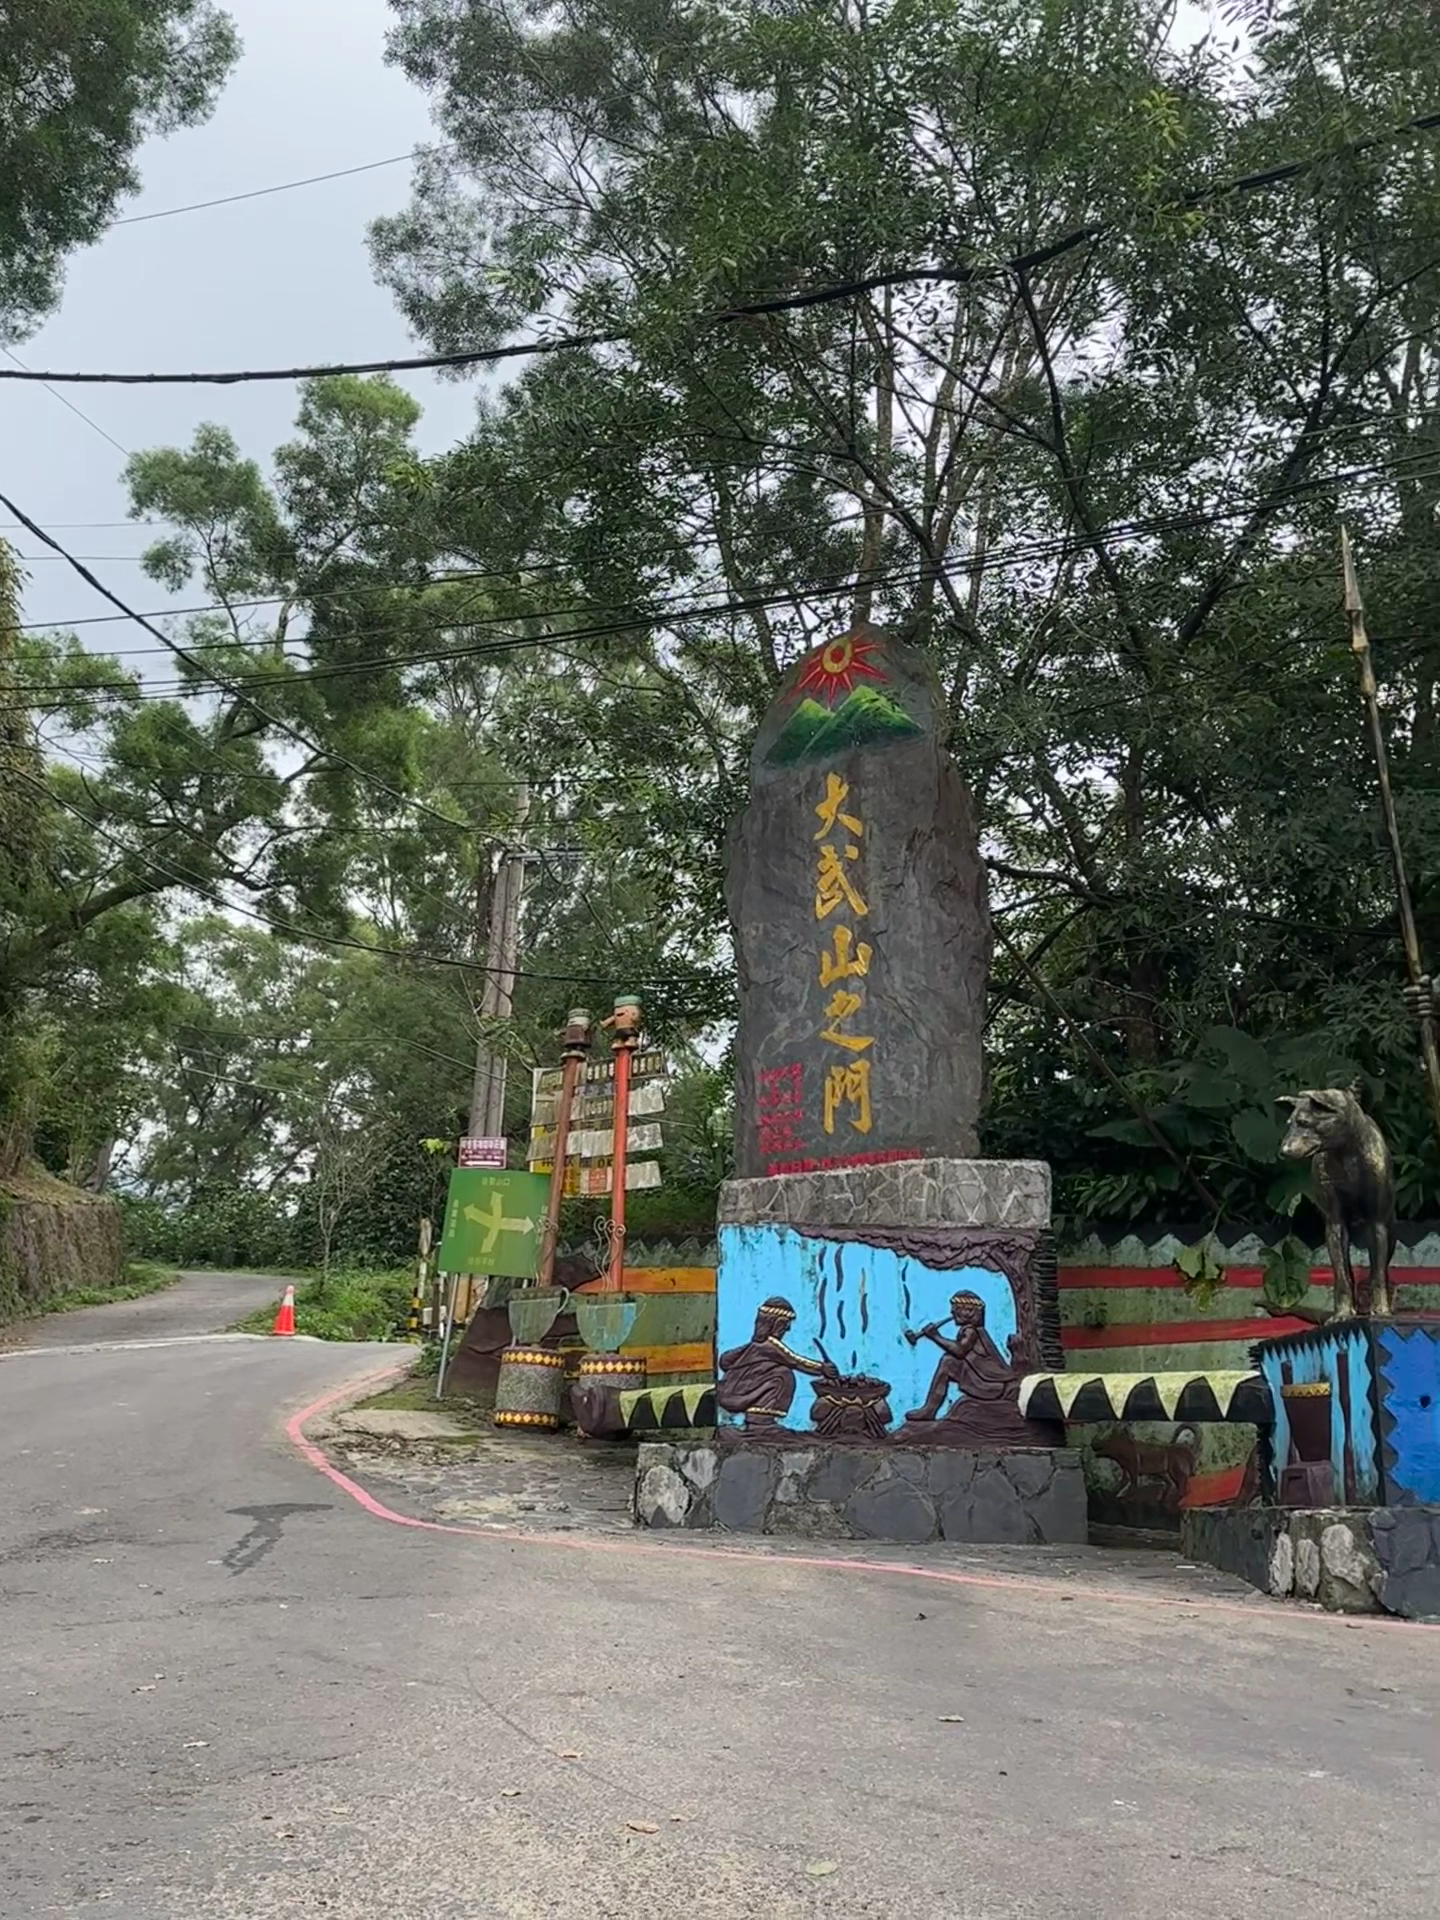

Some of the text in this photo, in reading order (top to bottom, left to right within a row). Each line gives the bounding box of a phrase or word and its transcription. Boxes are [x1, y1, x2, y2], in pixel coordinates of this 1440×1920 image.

[813, 771, 876, 1135] 大武山之門
